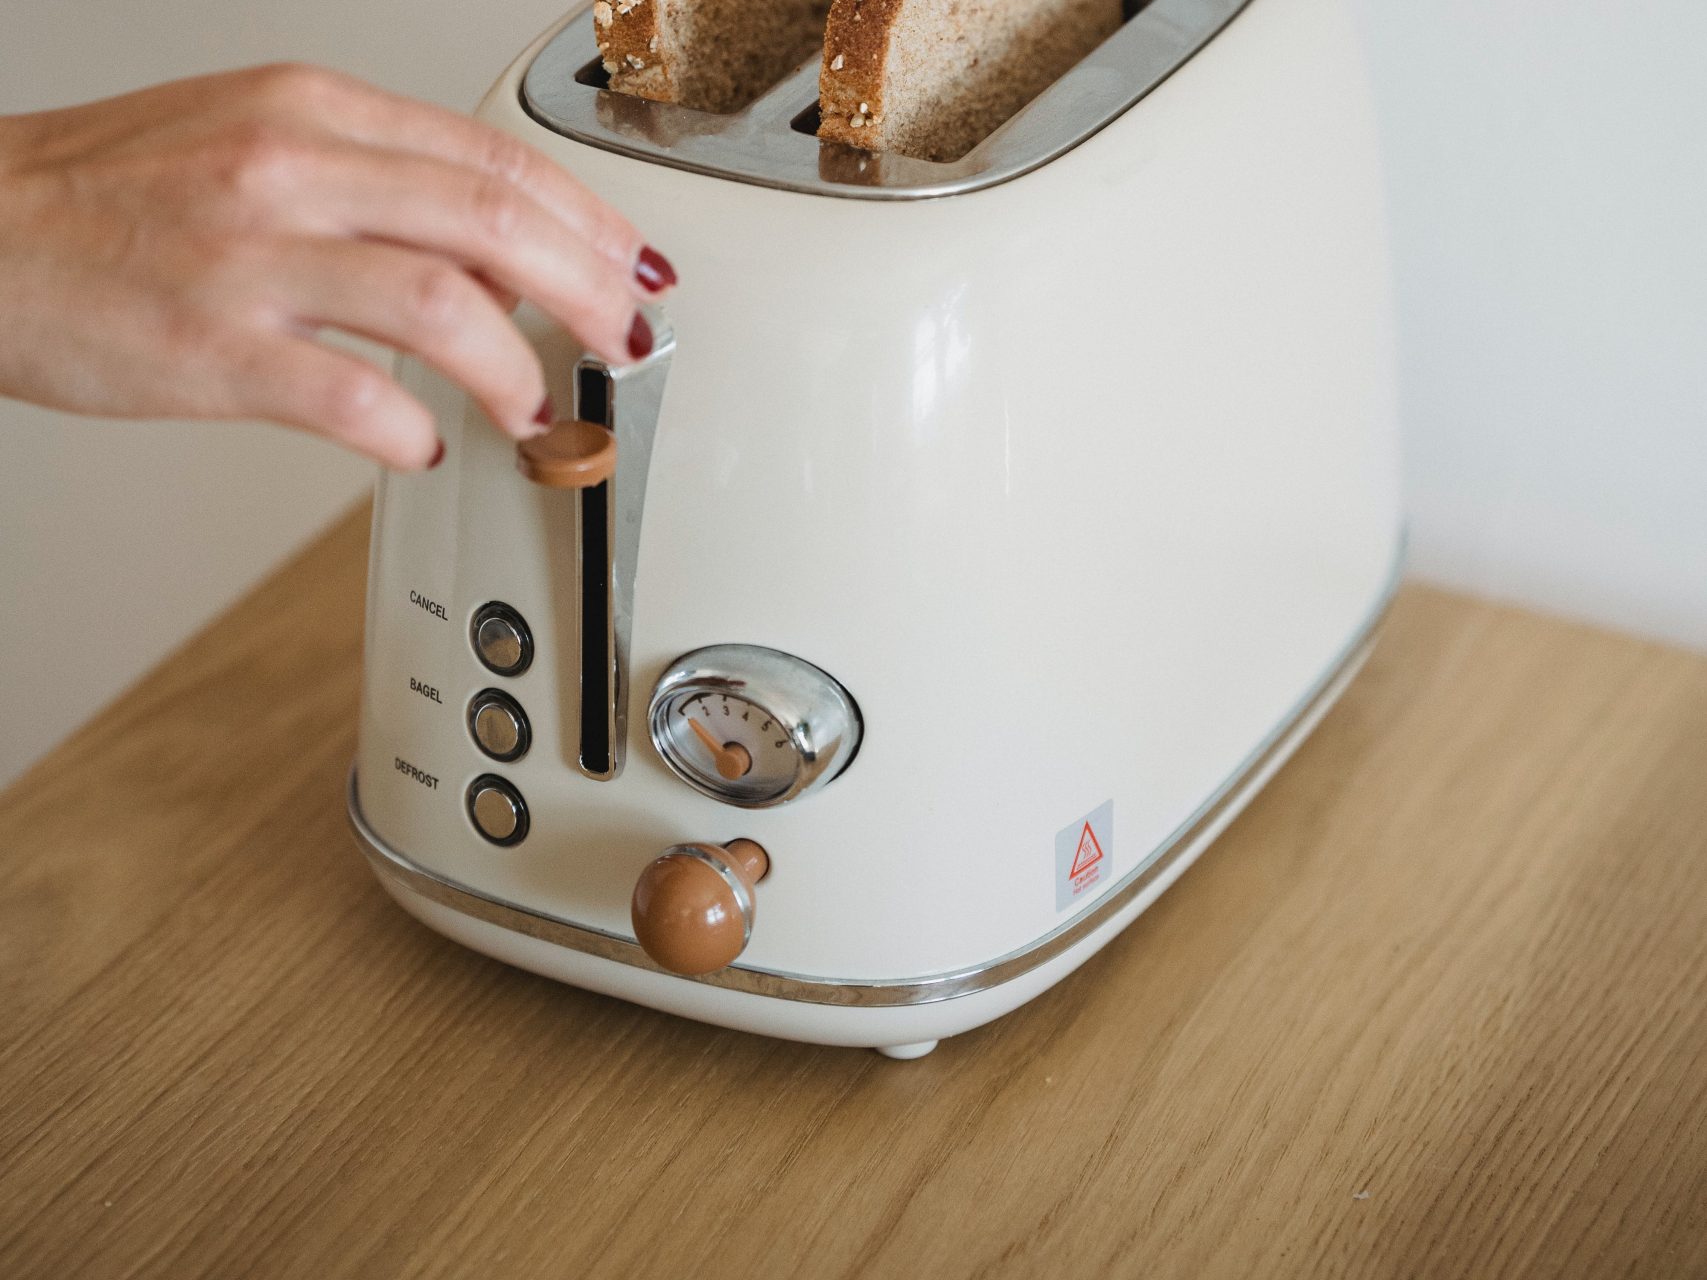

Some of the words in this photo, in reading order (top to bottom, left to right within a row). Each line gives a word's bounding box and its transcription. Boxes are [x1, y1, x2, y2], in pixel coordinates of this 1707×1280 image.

[409, 590, 448, 621] CANCEL
[409, 677, 442, 704] BAGEL
[702, 705, 711, 717] 2
[723, 705, 730, 716] 3
[742, 711, 749, 722] 4
[761, 720, 772, 732] 5
[775, 739, 786, 749] 6
[395, 757, 439, 790] DEFROST
